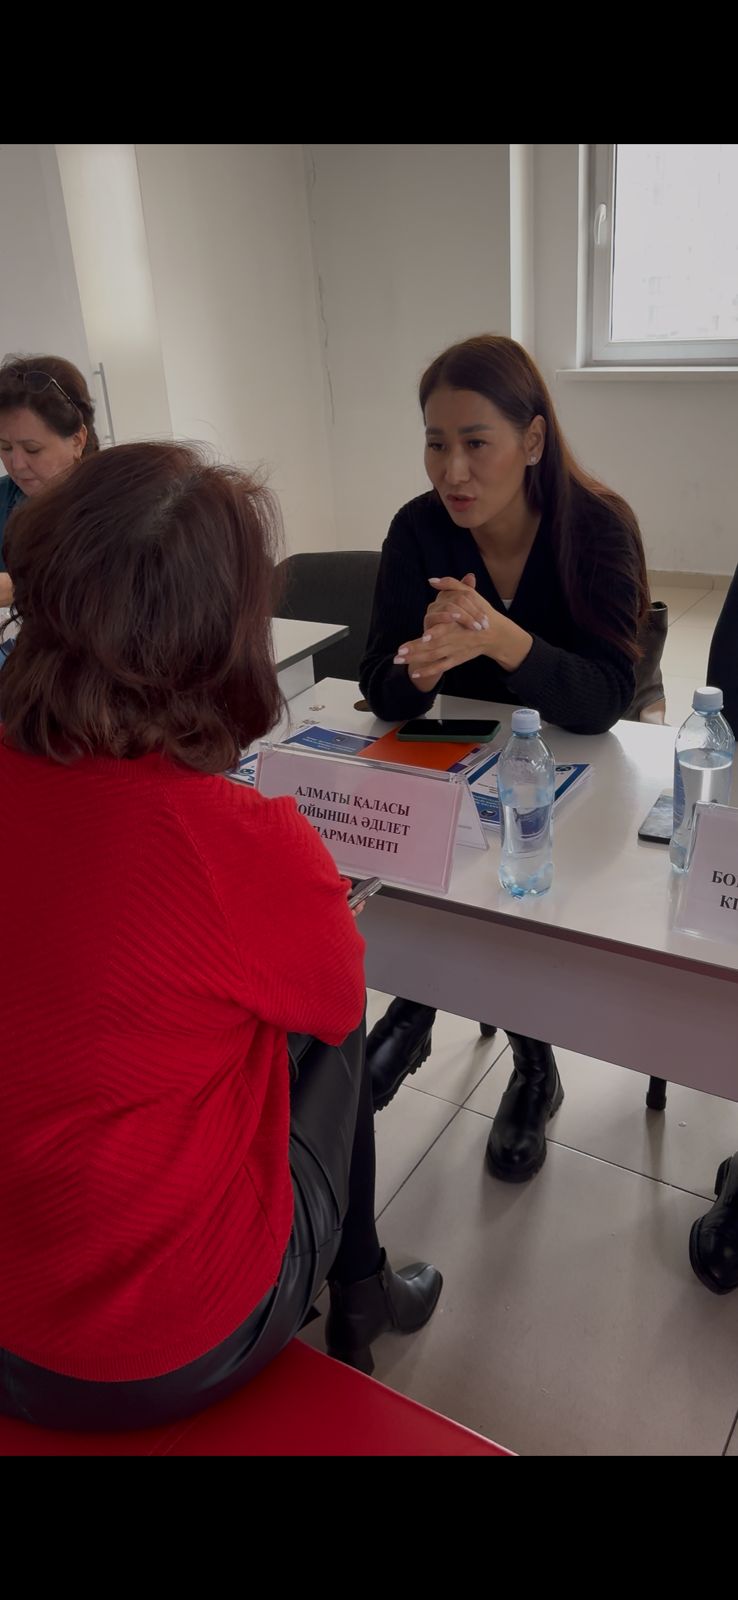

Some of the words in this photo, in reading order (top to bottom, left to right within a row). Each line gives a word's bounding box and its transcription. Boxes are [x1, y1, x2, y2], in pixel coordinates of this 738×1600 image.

[294, 785, 351, 806] АЛМАТЫ
[353, 795, 411, 817] ҚАЛАСЫ
[297, 803, 358, 826] ОЙЫНША
[361, 816, 411, 836] ӘДІЛЕТ
[711, 870, 738, 888] БО
